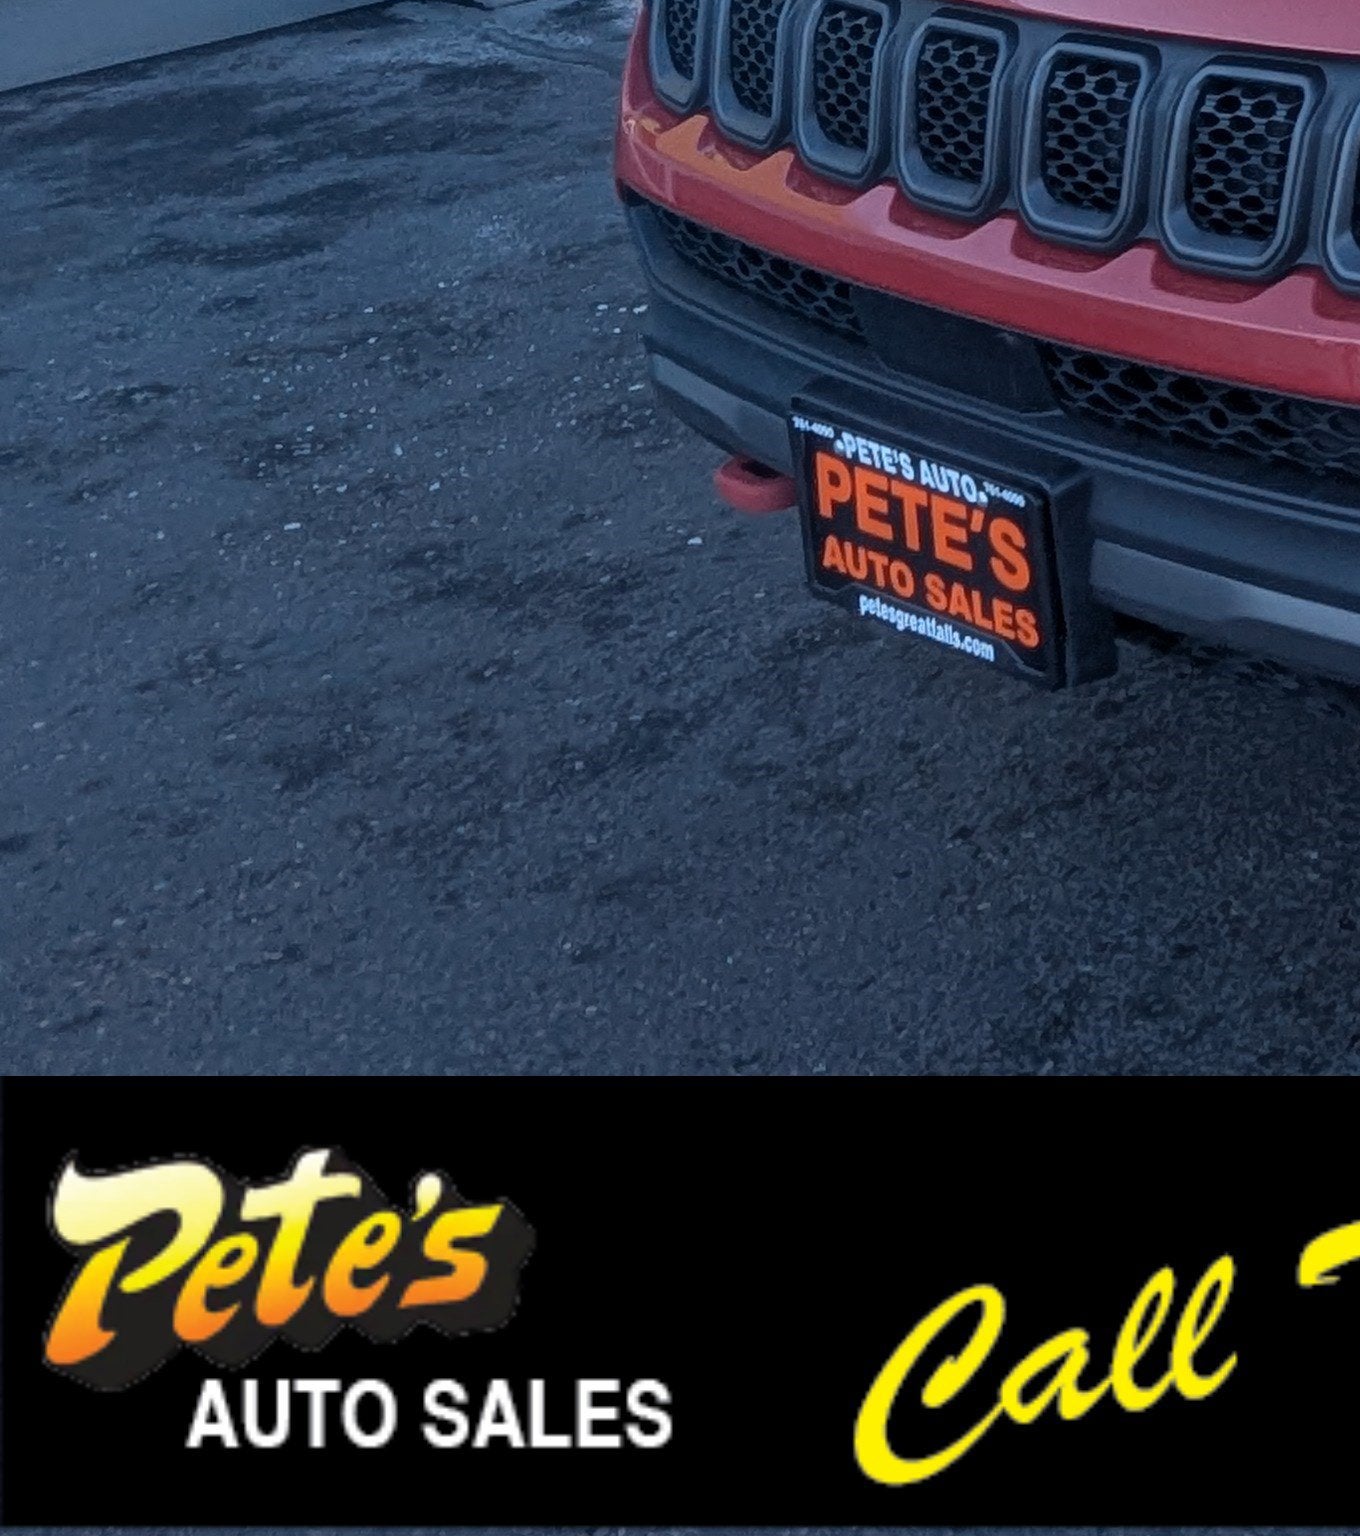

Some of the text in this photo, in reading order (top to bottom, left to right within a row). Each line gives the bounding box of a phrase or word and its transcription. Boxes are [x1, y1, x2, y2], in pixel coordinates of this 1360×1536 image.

[840, 431, 915, 481] PETE'S
[918, 458, 979, 504] AUTO
[816, 451, 1030, 591] PETE'S
[822, 535, 1040, 648] AUTO SALES
[859, 594, 995, 662] petesgreatfalls.com
